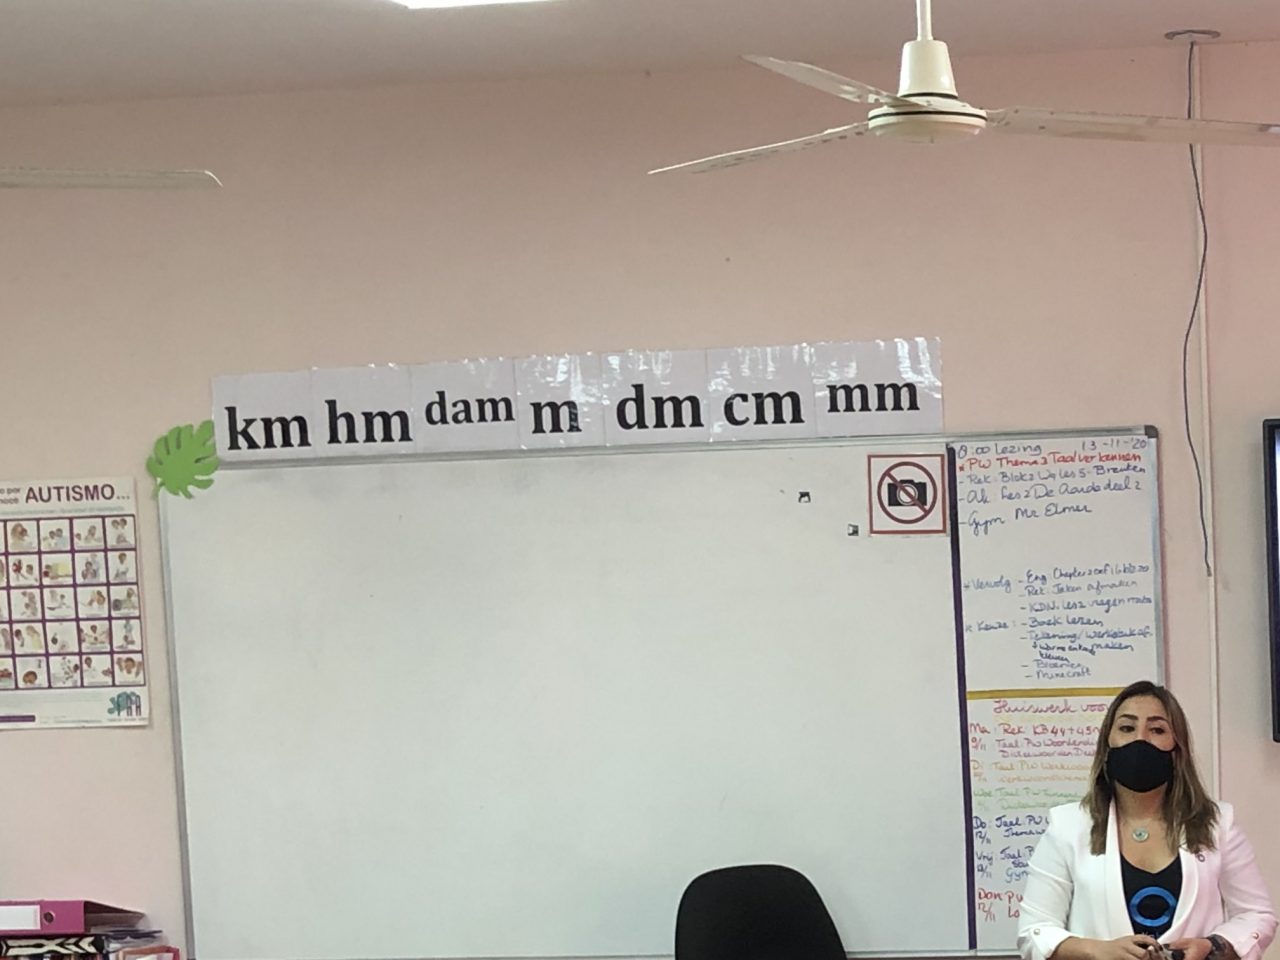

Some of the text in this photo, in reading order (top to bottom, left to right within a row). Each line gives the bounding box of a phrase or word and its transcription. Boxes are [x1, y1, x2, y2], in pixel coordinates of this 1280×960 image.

[224, 380, 920, 451] km hm dam m dm cm mm
[994, 442, 1042, 457] Lezing
[967, 510, 1005, 537] Gym
